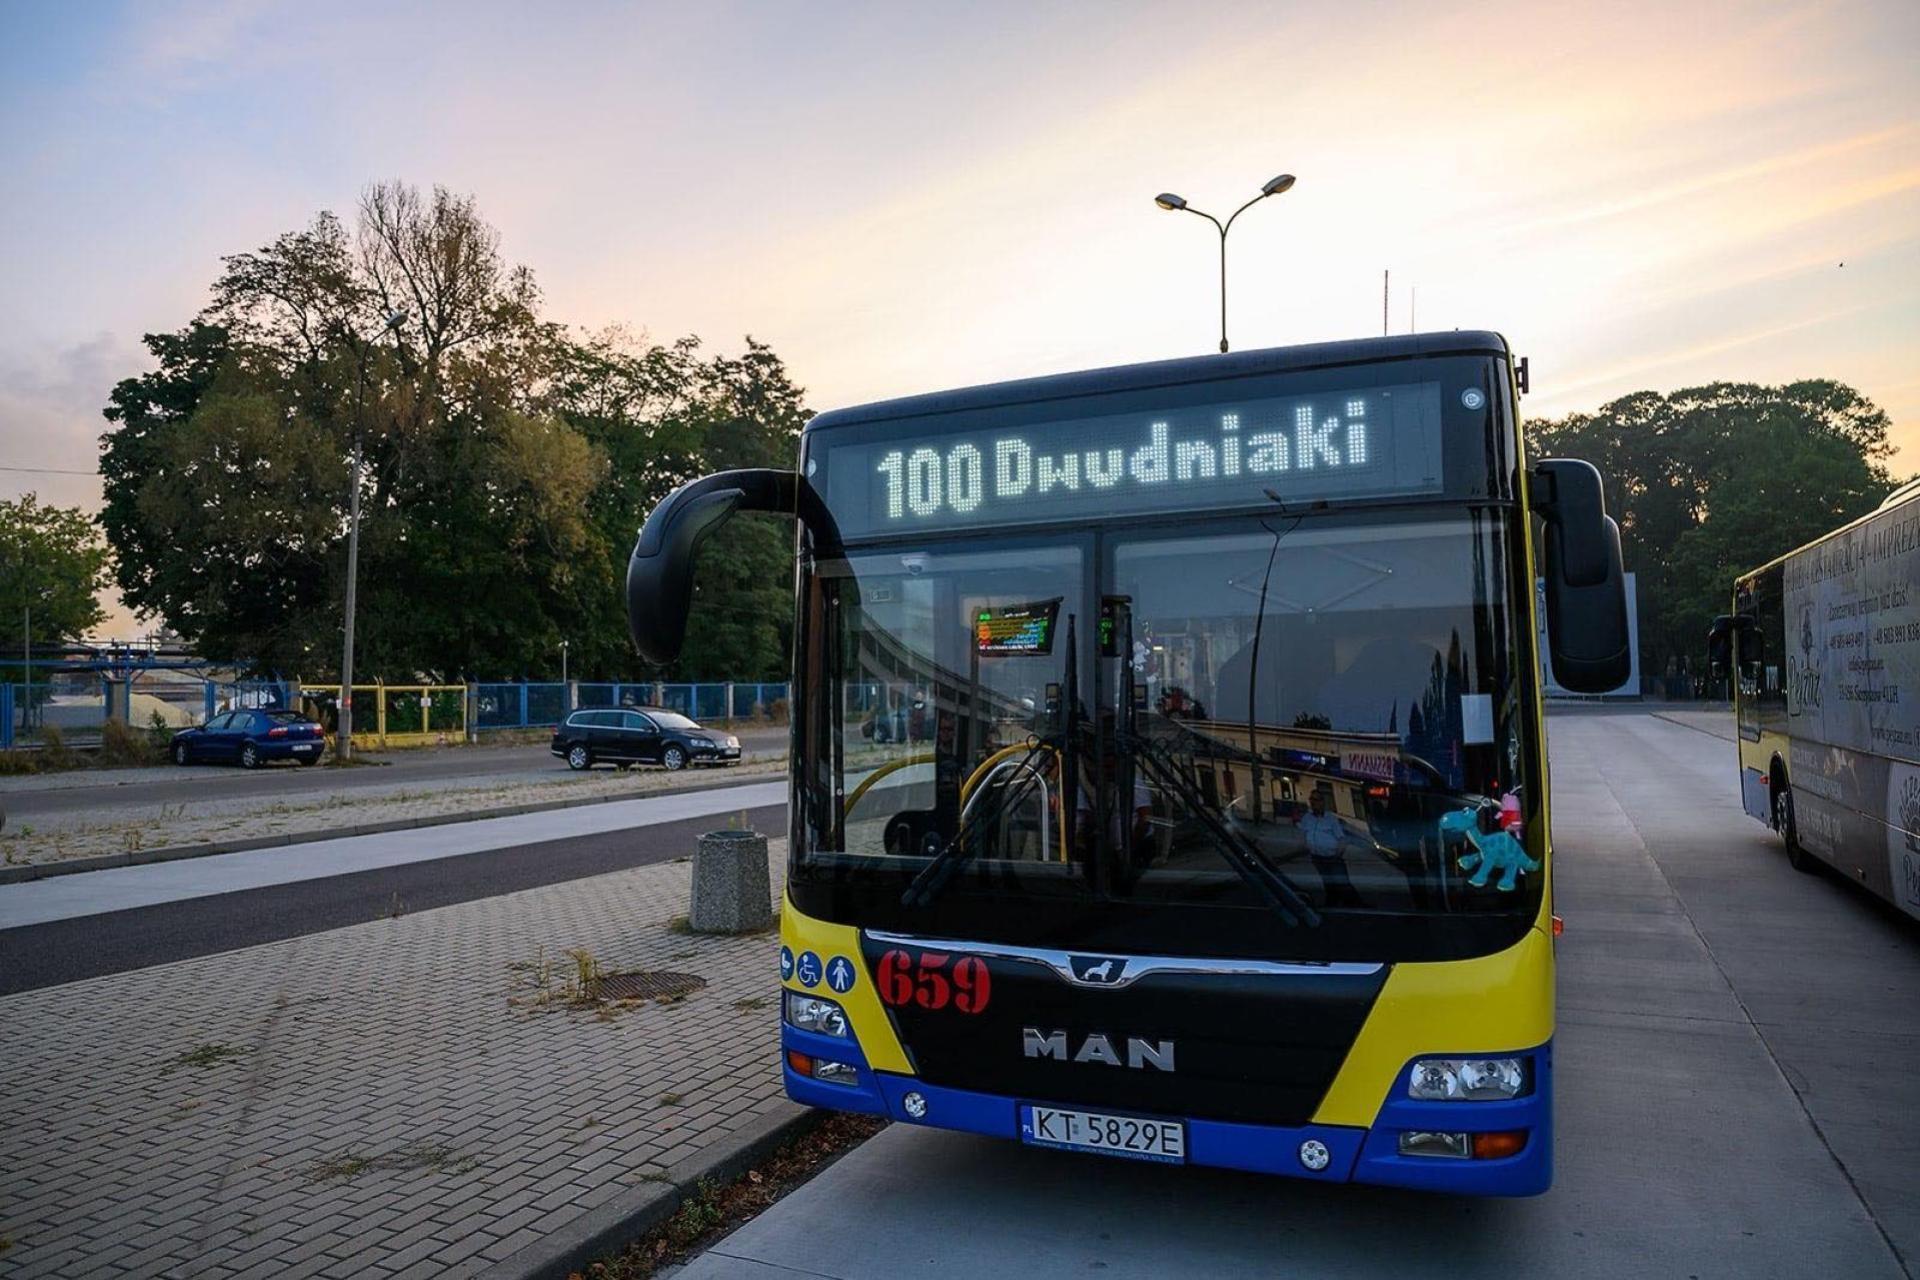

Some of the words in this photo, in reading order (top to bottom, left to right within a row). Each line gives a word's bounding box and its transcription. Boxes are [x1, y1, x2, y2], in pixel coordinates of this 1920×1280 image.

[876, 443, 982, 518] 100
[995, 400, 1367, 497] Dwudniaki
[877, 949, 991, 1014] 659
[1022, 1028, 1175, 1072] MAN
[1037, 1110, 1076, 1141] KT
[1087, 1116, 1179, 1155] 5829E
